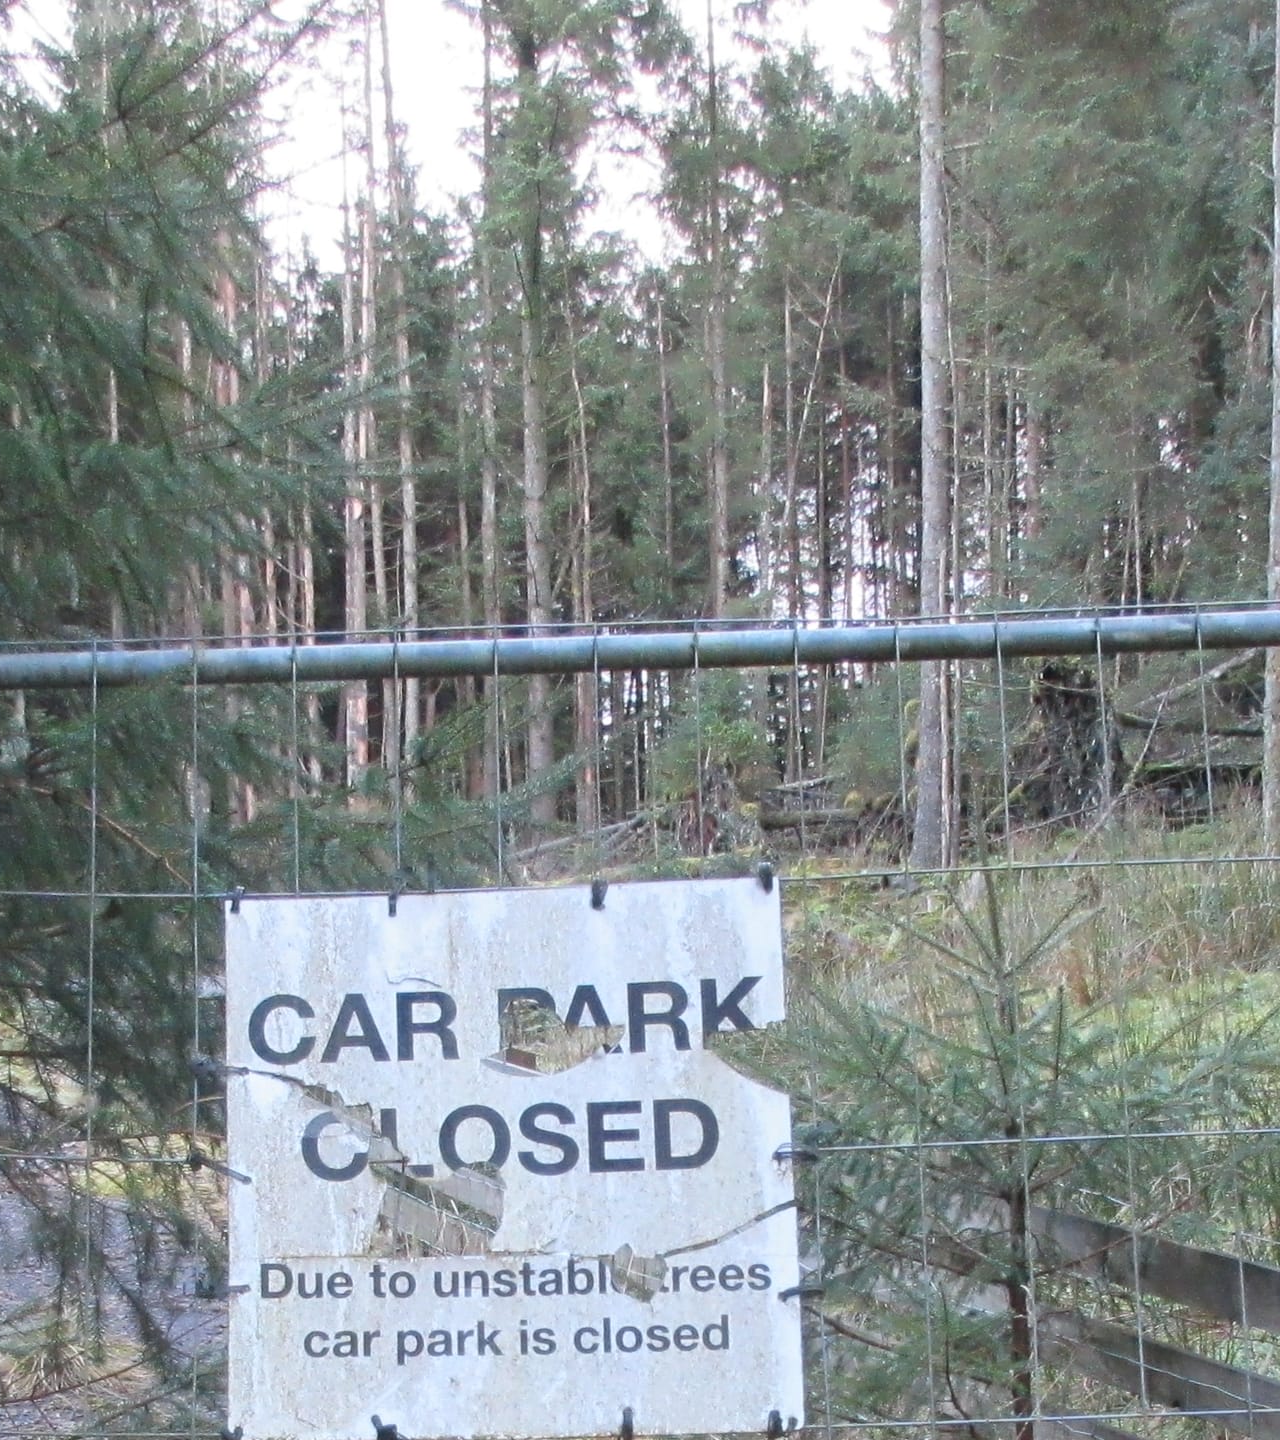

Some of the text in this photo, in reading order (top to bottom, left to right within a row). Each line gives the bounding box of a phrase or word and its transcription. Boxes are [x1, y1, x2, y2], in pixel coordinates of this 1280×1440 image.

[247, 990, 460, 1066] CAR
[260, 1263, 354, 1299] Due
[369, 1264, 417, 1298] to
[433, 1258, 628, 1298] unstabl
[303, 1314, 730, 1366] car park is closed
